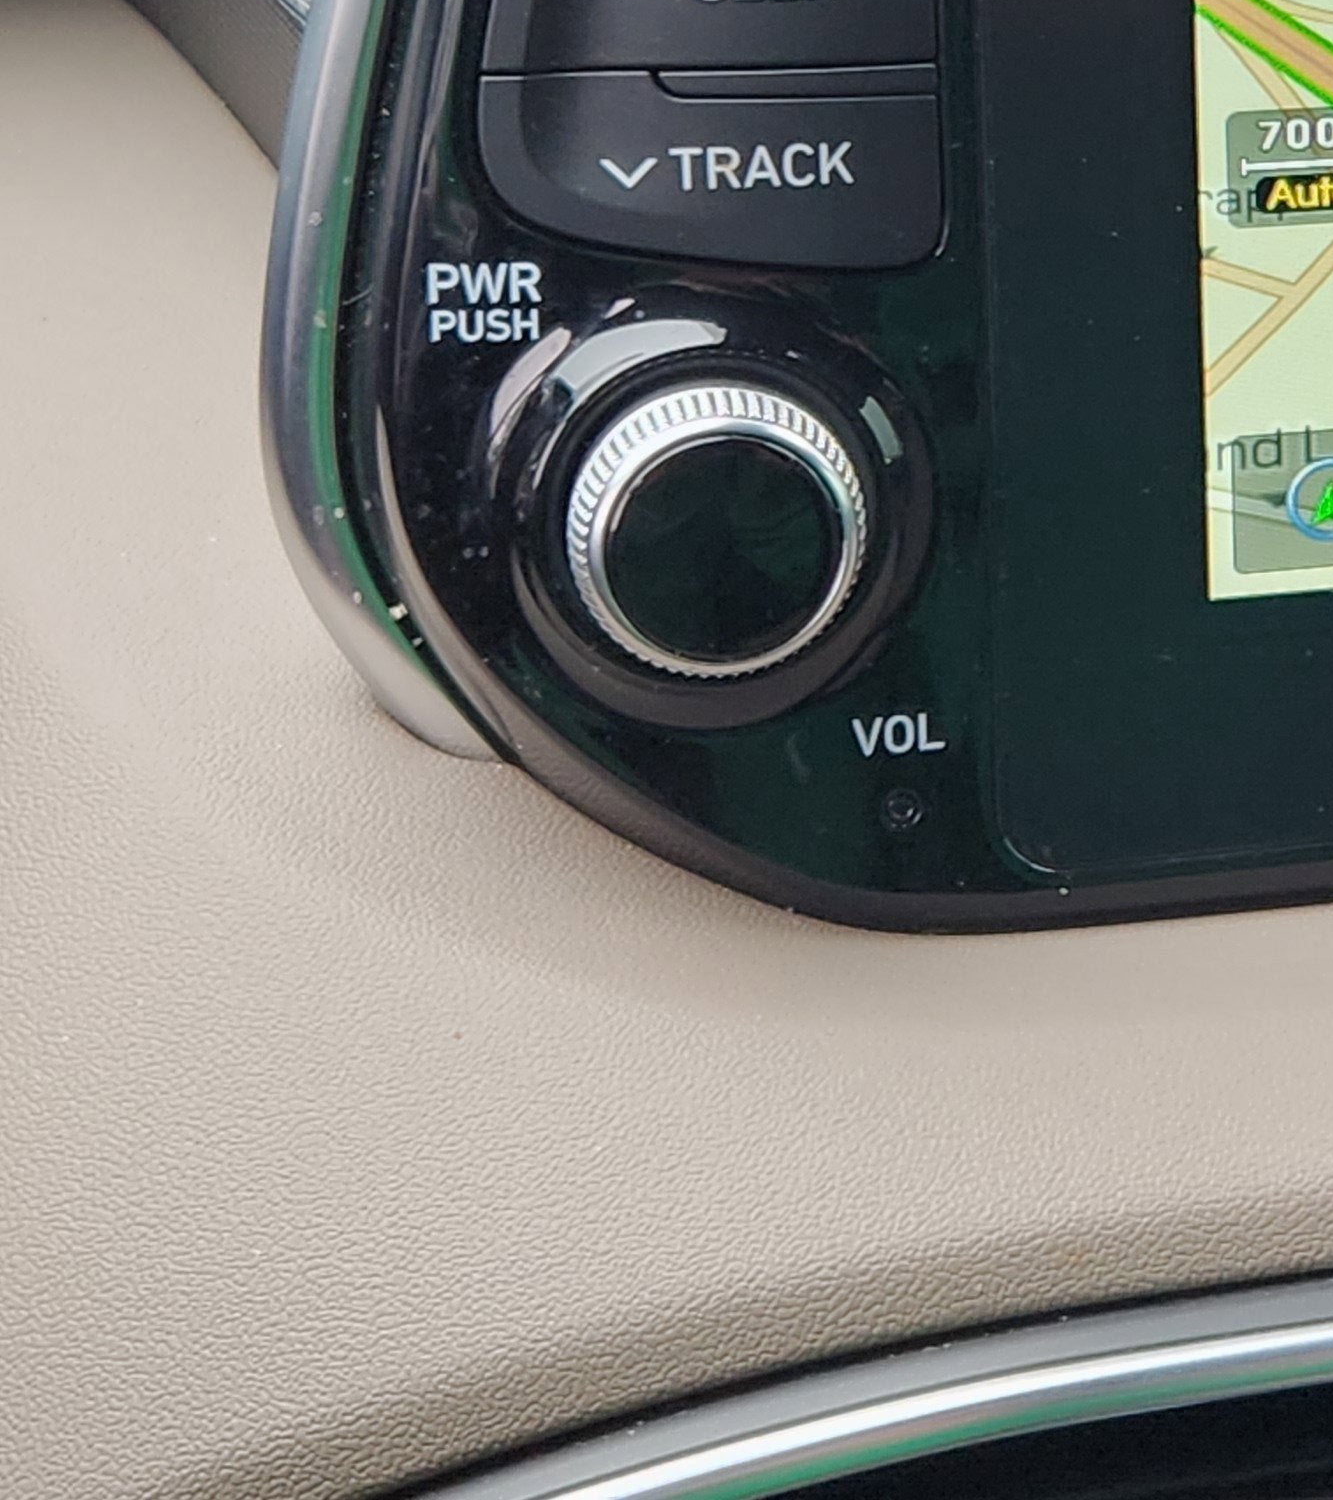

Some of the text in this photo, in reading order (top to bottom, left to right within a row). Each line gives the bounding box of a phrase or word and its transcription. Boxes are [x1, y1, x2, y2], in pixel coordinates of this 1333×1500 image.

[667, 140, 855, 192] TRACK
[426, 261, 543, 305] PWR
[429, 309, 541, 344] PUSH
[851, 711, 947, 758] VOL
